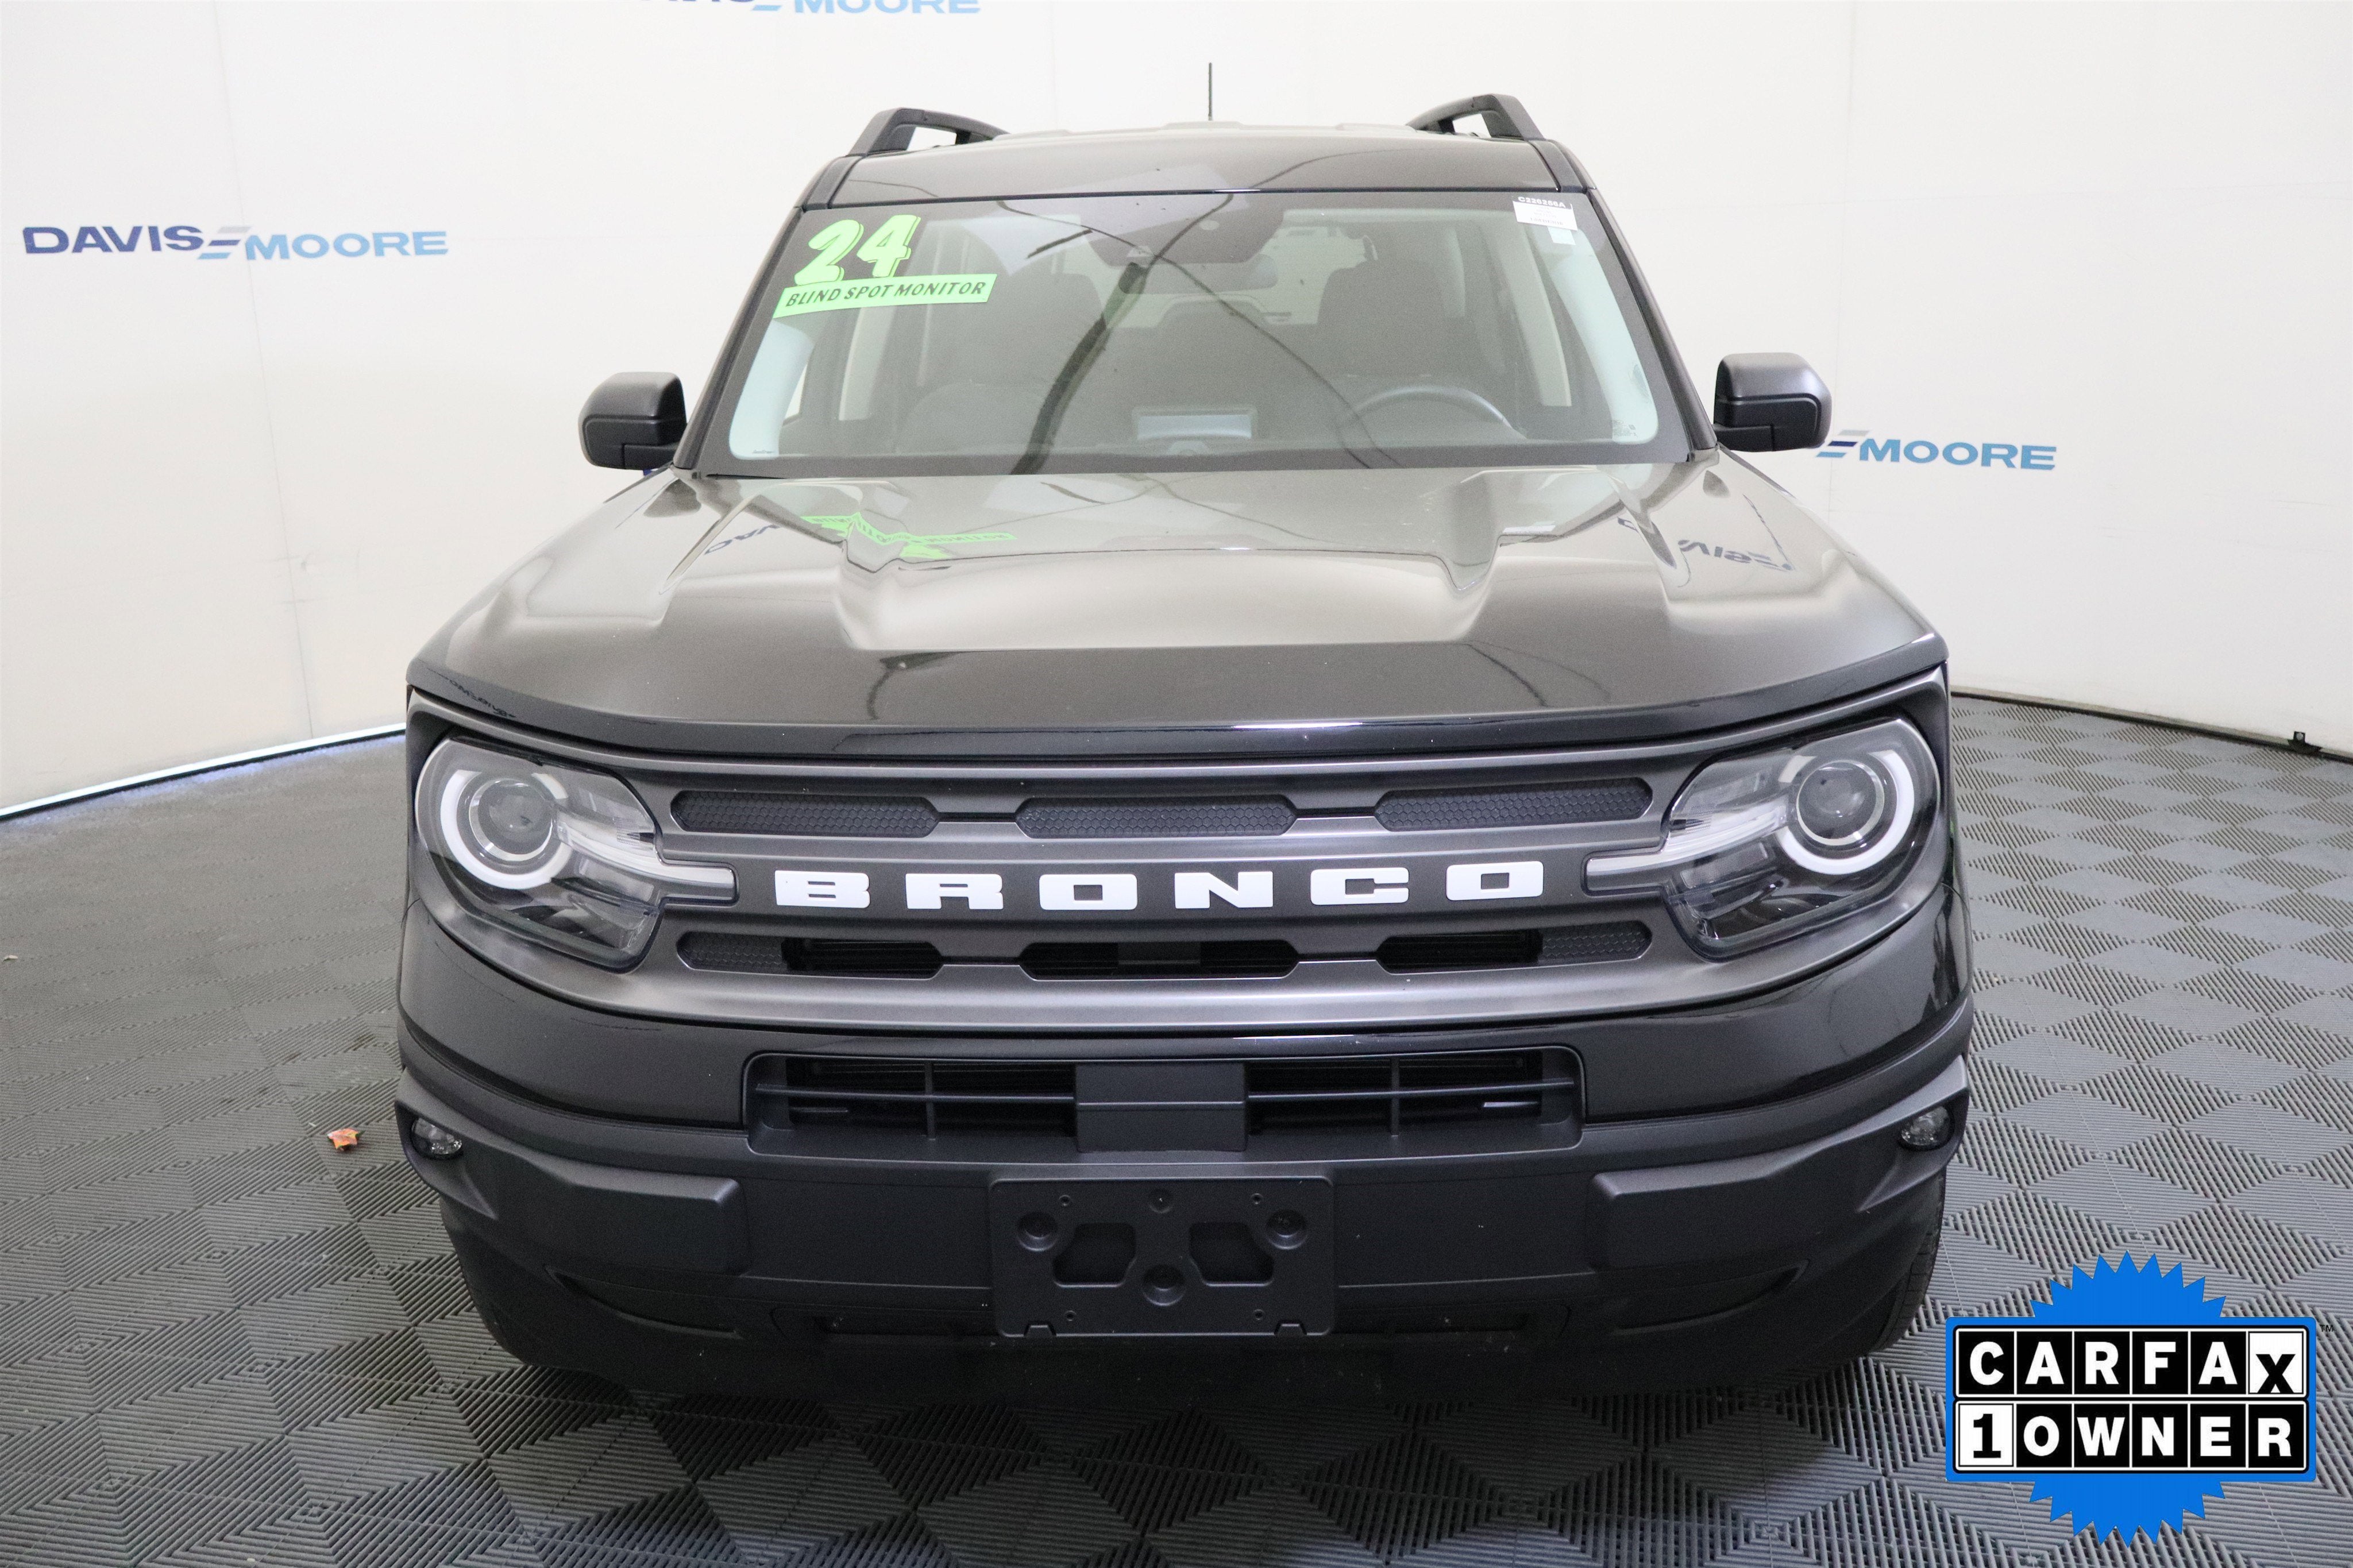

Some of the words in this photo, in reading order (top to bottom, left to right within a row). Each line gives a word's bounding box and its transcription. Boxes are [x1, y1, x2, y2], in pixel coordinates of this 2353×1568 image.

[22, 226, 204, 254] DAVIS
[244, 231, 449, 260] MOORE
[794, 214, 921, 285] 24
[785, 288, 842, 307] BLIND
[844, 285, 894, 299] SPOT
[894, 282, 986, 296] MONITOR
[1859, 438, 2057, 470] MOORE
[773, 860, 1544, 910] BRONCO
